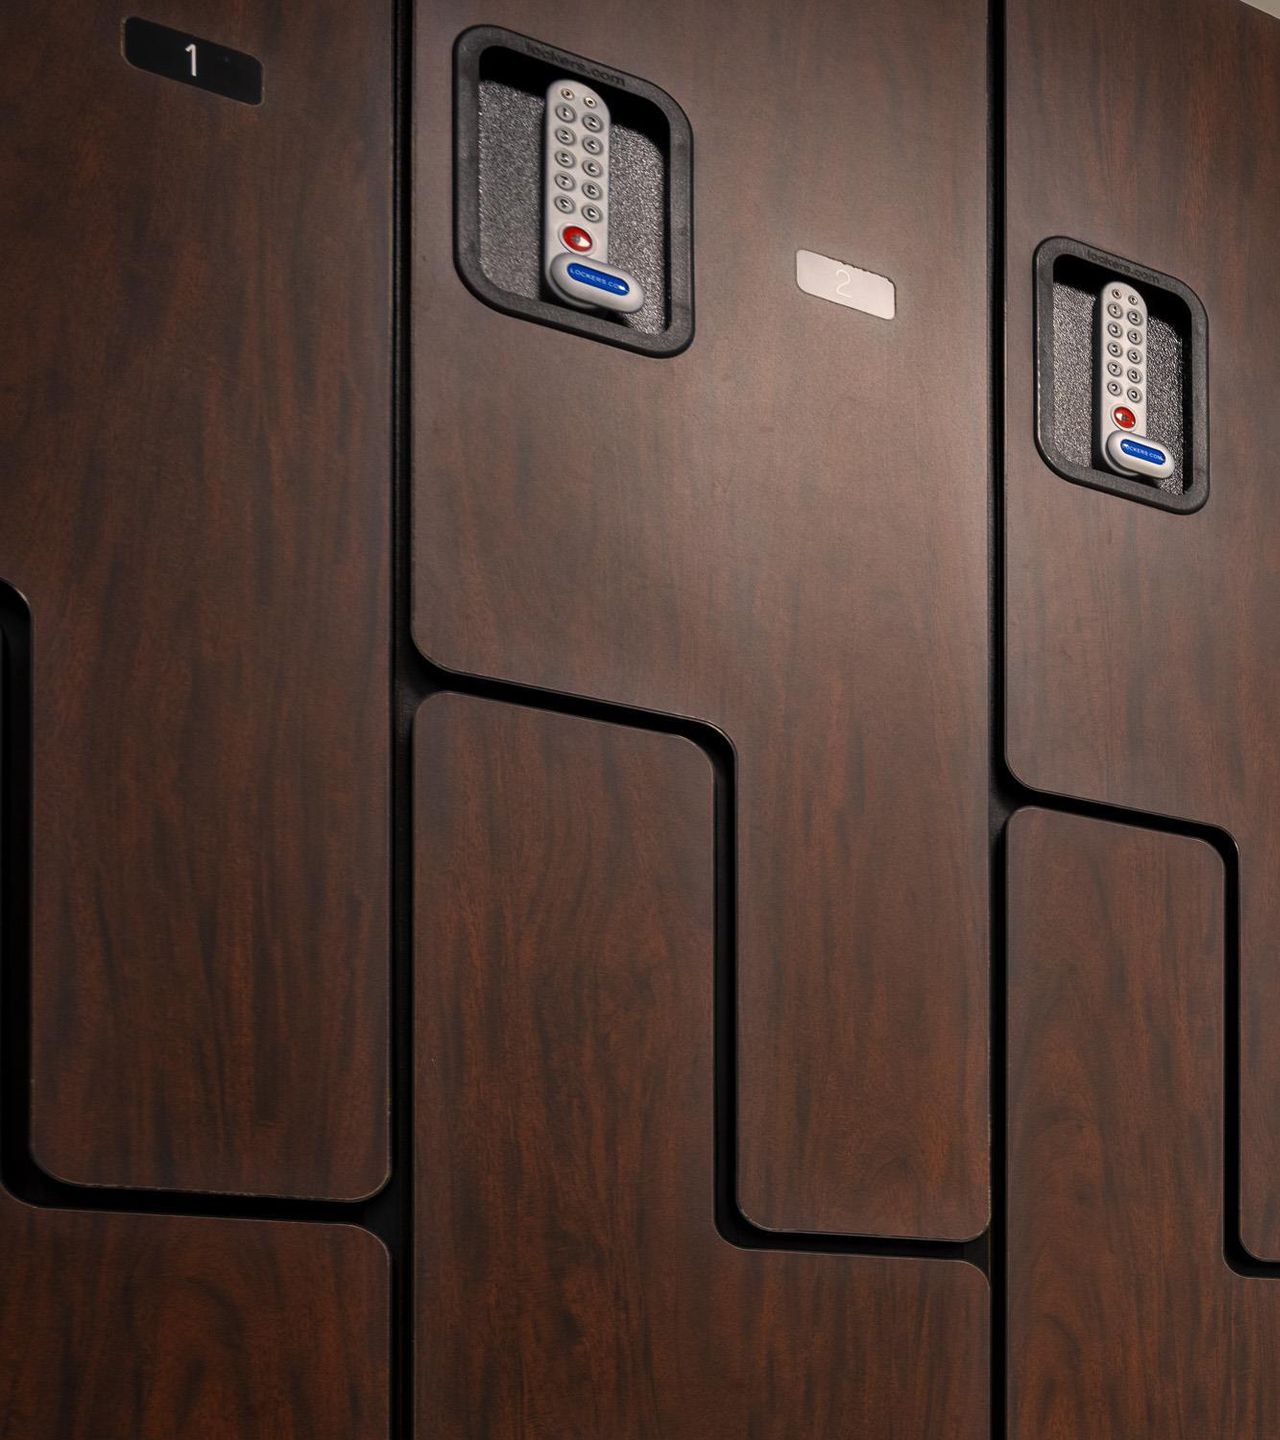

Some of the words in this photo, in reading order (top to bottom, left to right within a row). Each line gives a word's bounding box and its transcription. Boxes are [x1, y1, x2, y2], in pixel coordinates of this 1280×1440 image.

[185, 43, 197, 77] 1
[525, 42, 626, 88] lockers.com
[834, 268, 853, 298] 2
[1088, 251, 1160, 284] lockers.com
